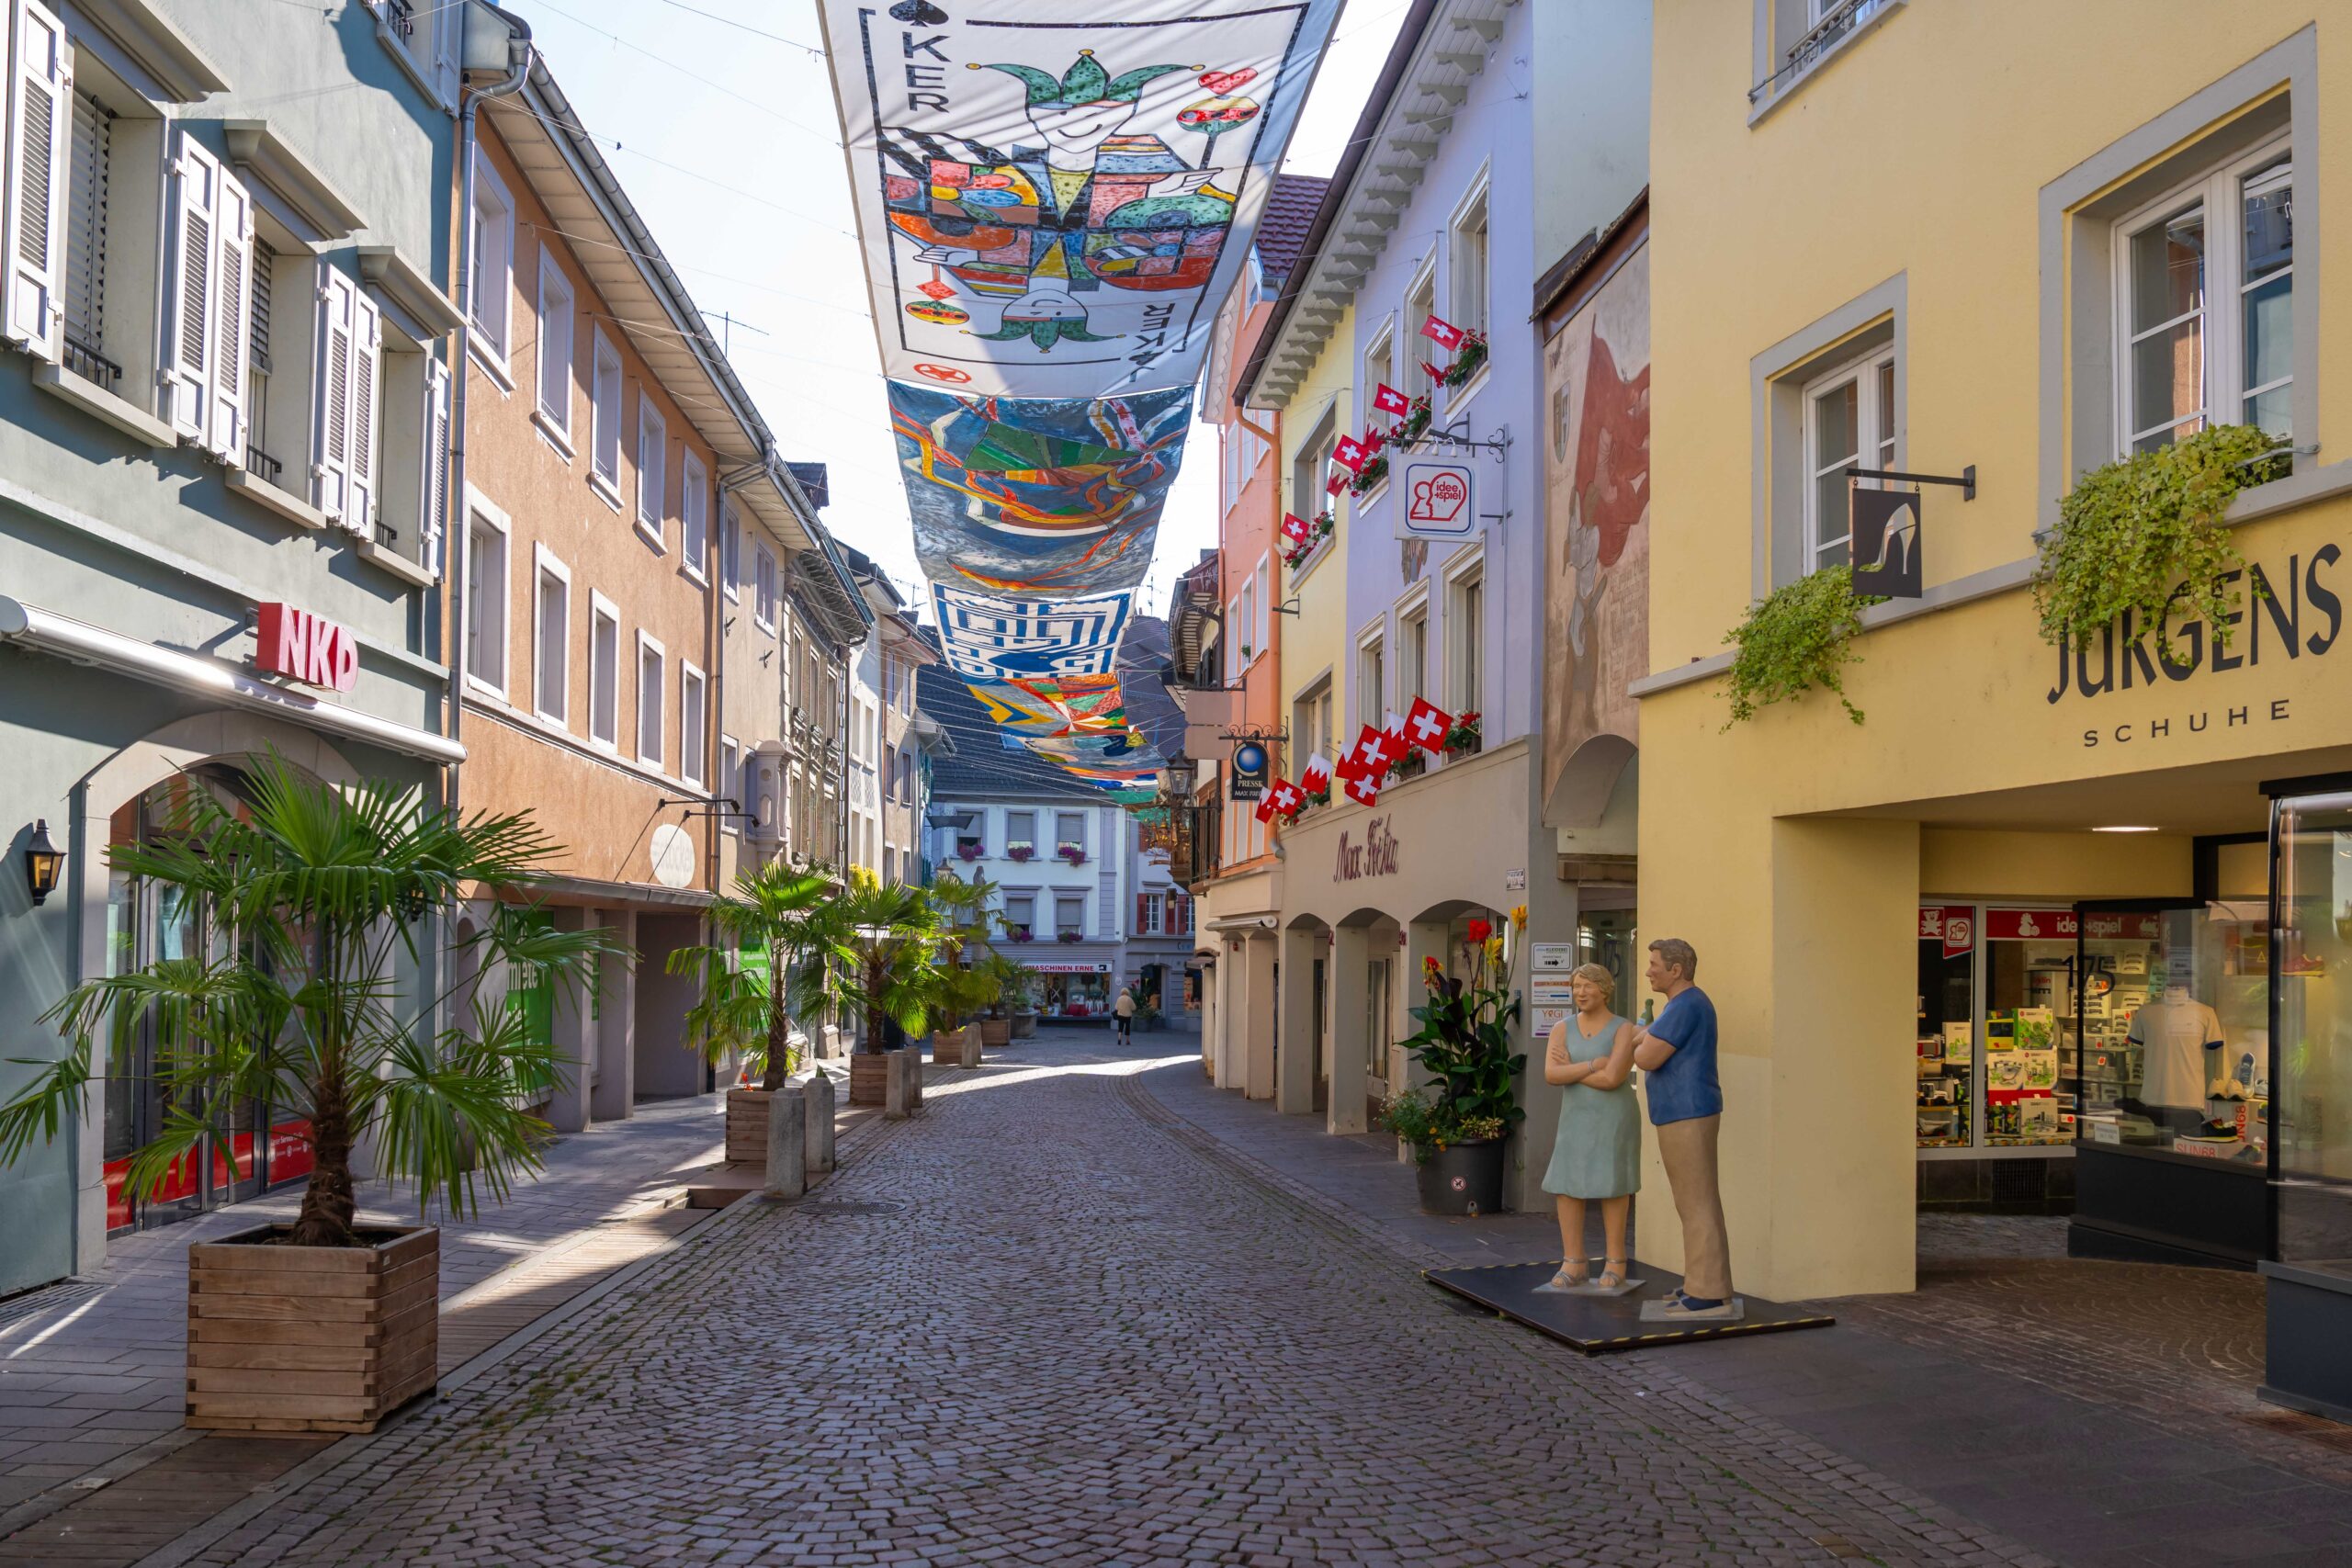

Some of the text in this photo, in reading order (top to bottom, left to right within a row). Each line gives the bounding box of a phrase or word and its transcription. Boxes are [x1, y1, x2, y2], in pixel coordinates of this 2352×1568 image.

[1436, 480, 1459, 492] idee
[274, 602, 358, 694] NKD
[2083, 698, 2290, 748] SCHUHE
